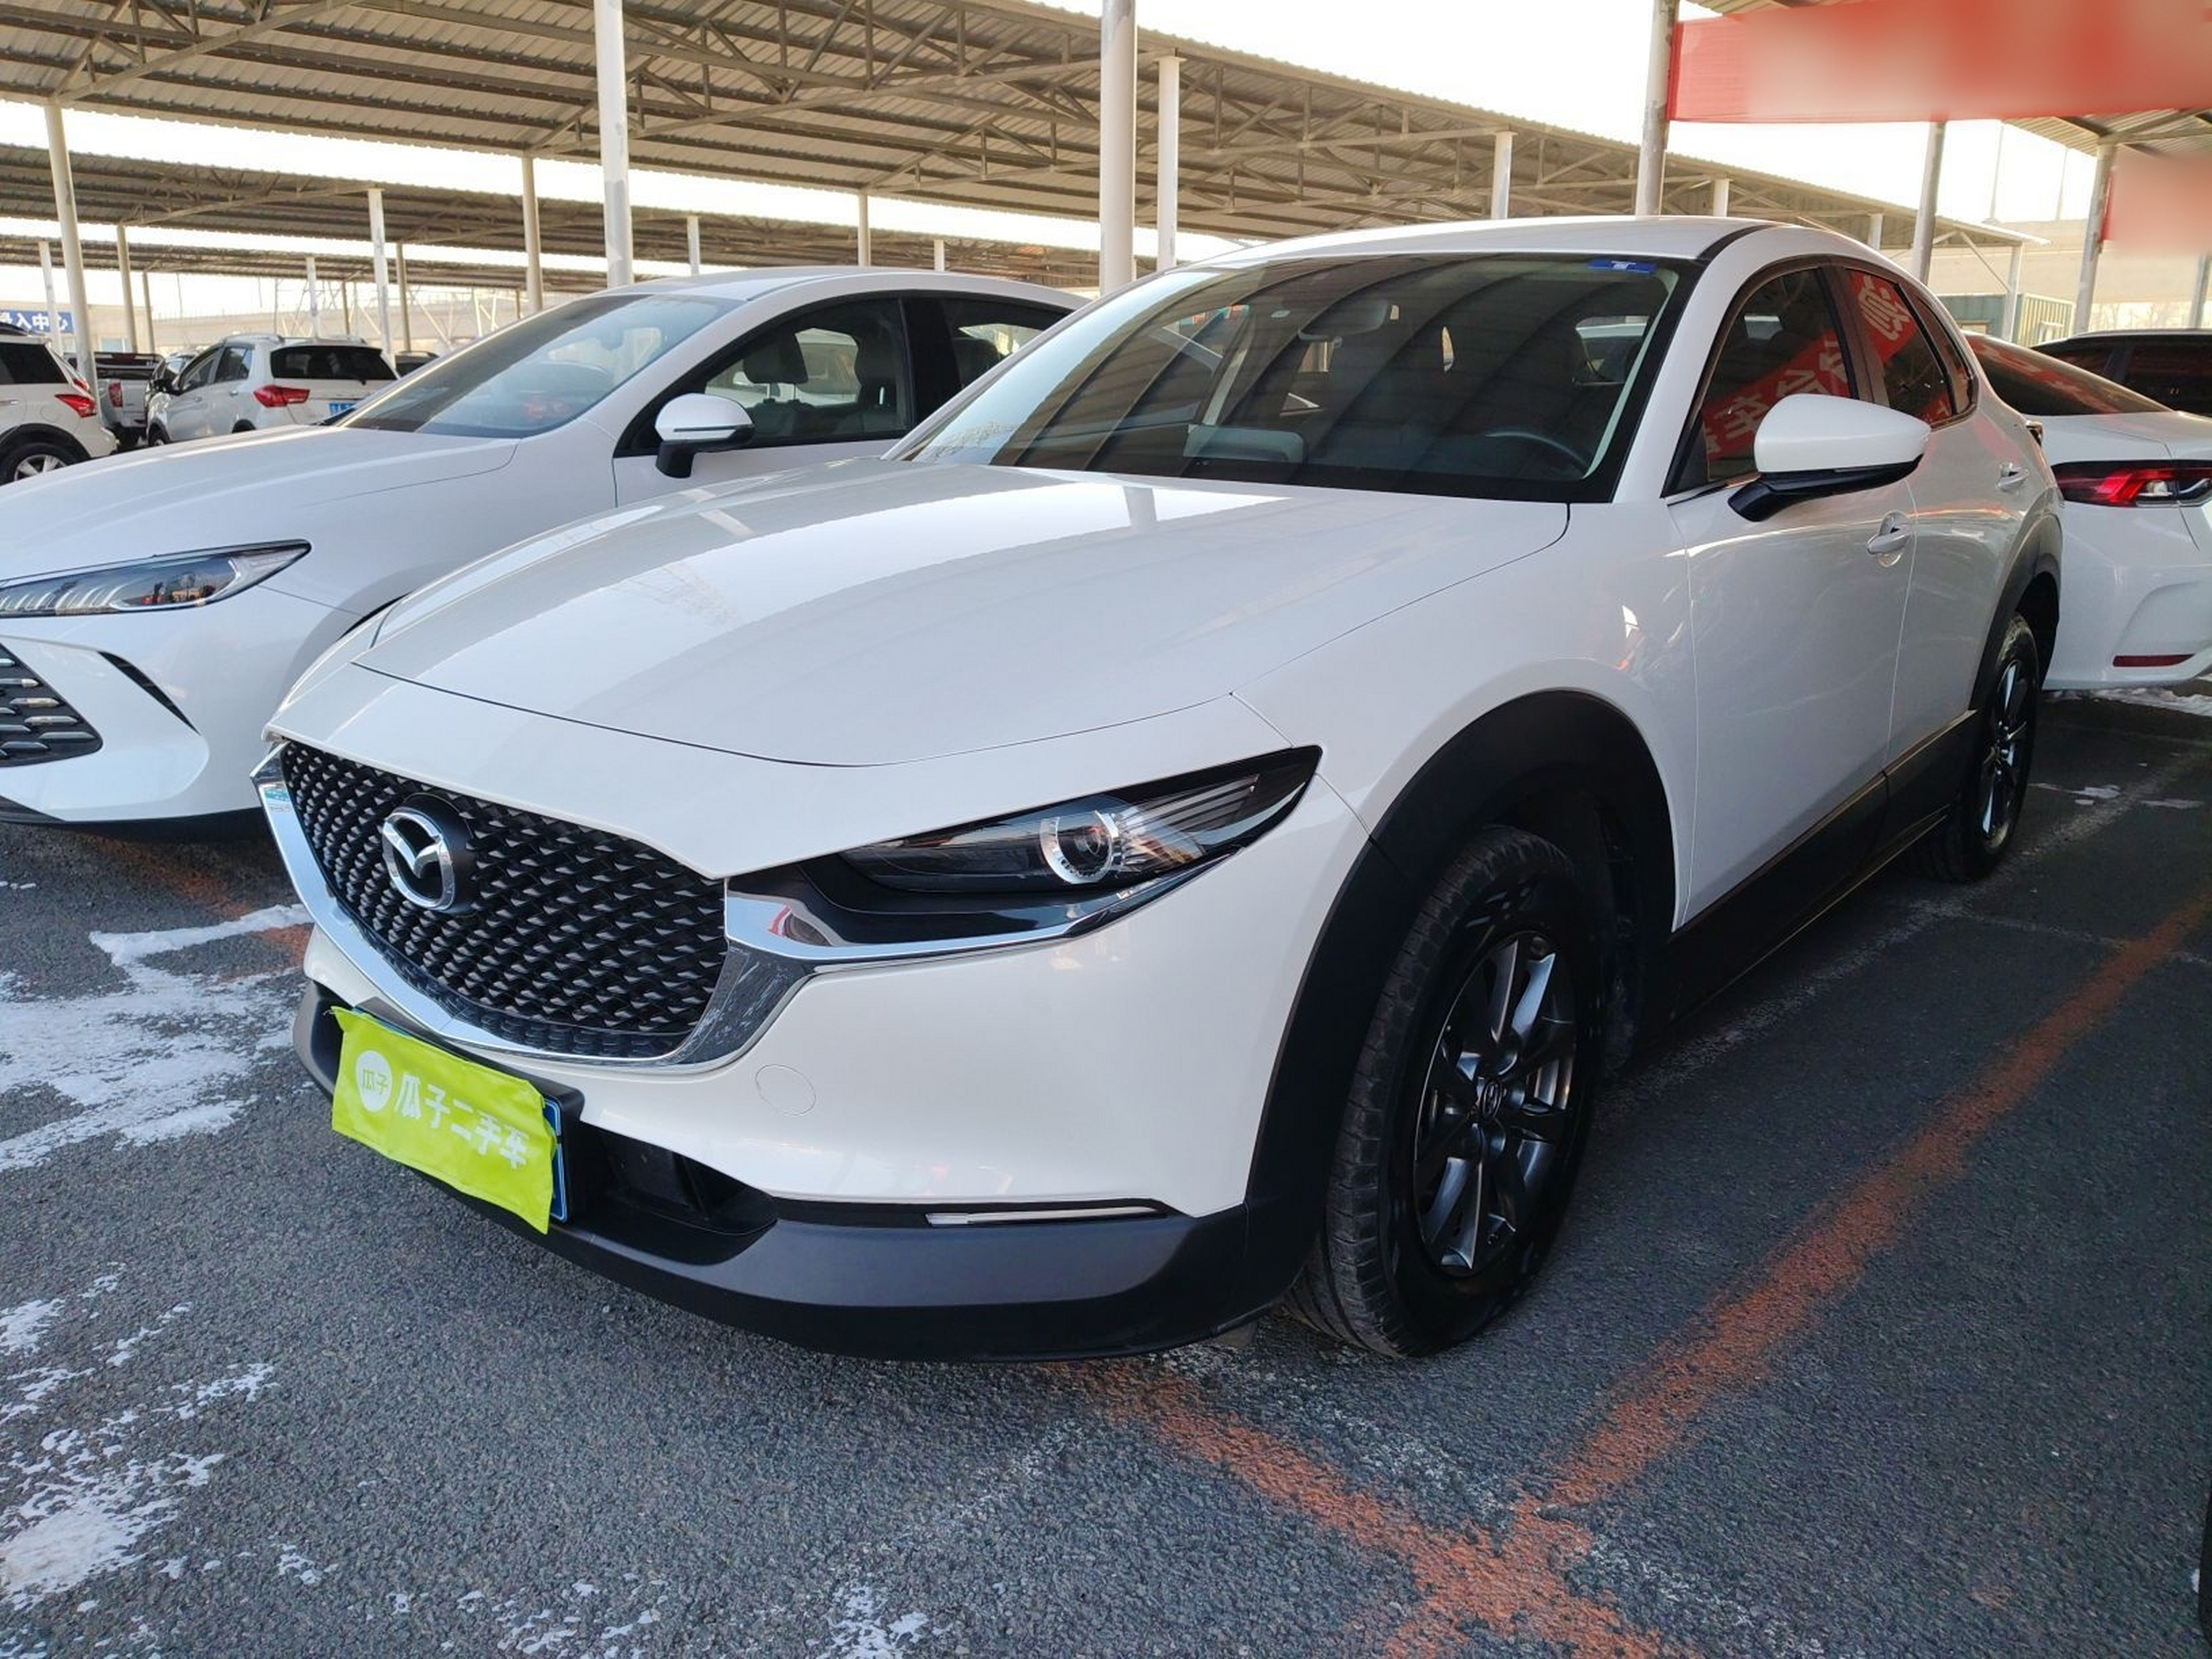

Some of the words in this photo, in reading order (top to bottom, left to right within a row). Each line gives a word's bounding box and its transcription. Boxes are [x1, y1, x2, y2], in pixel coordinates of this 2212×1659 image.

[362, 1068, 388, 1096] 瓜子
[394, 1074, 529, 1169] 瓜子二手车
